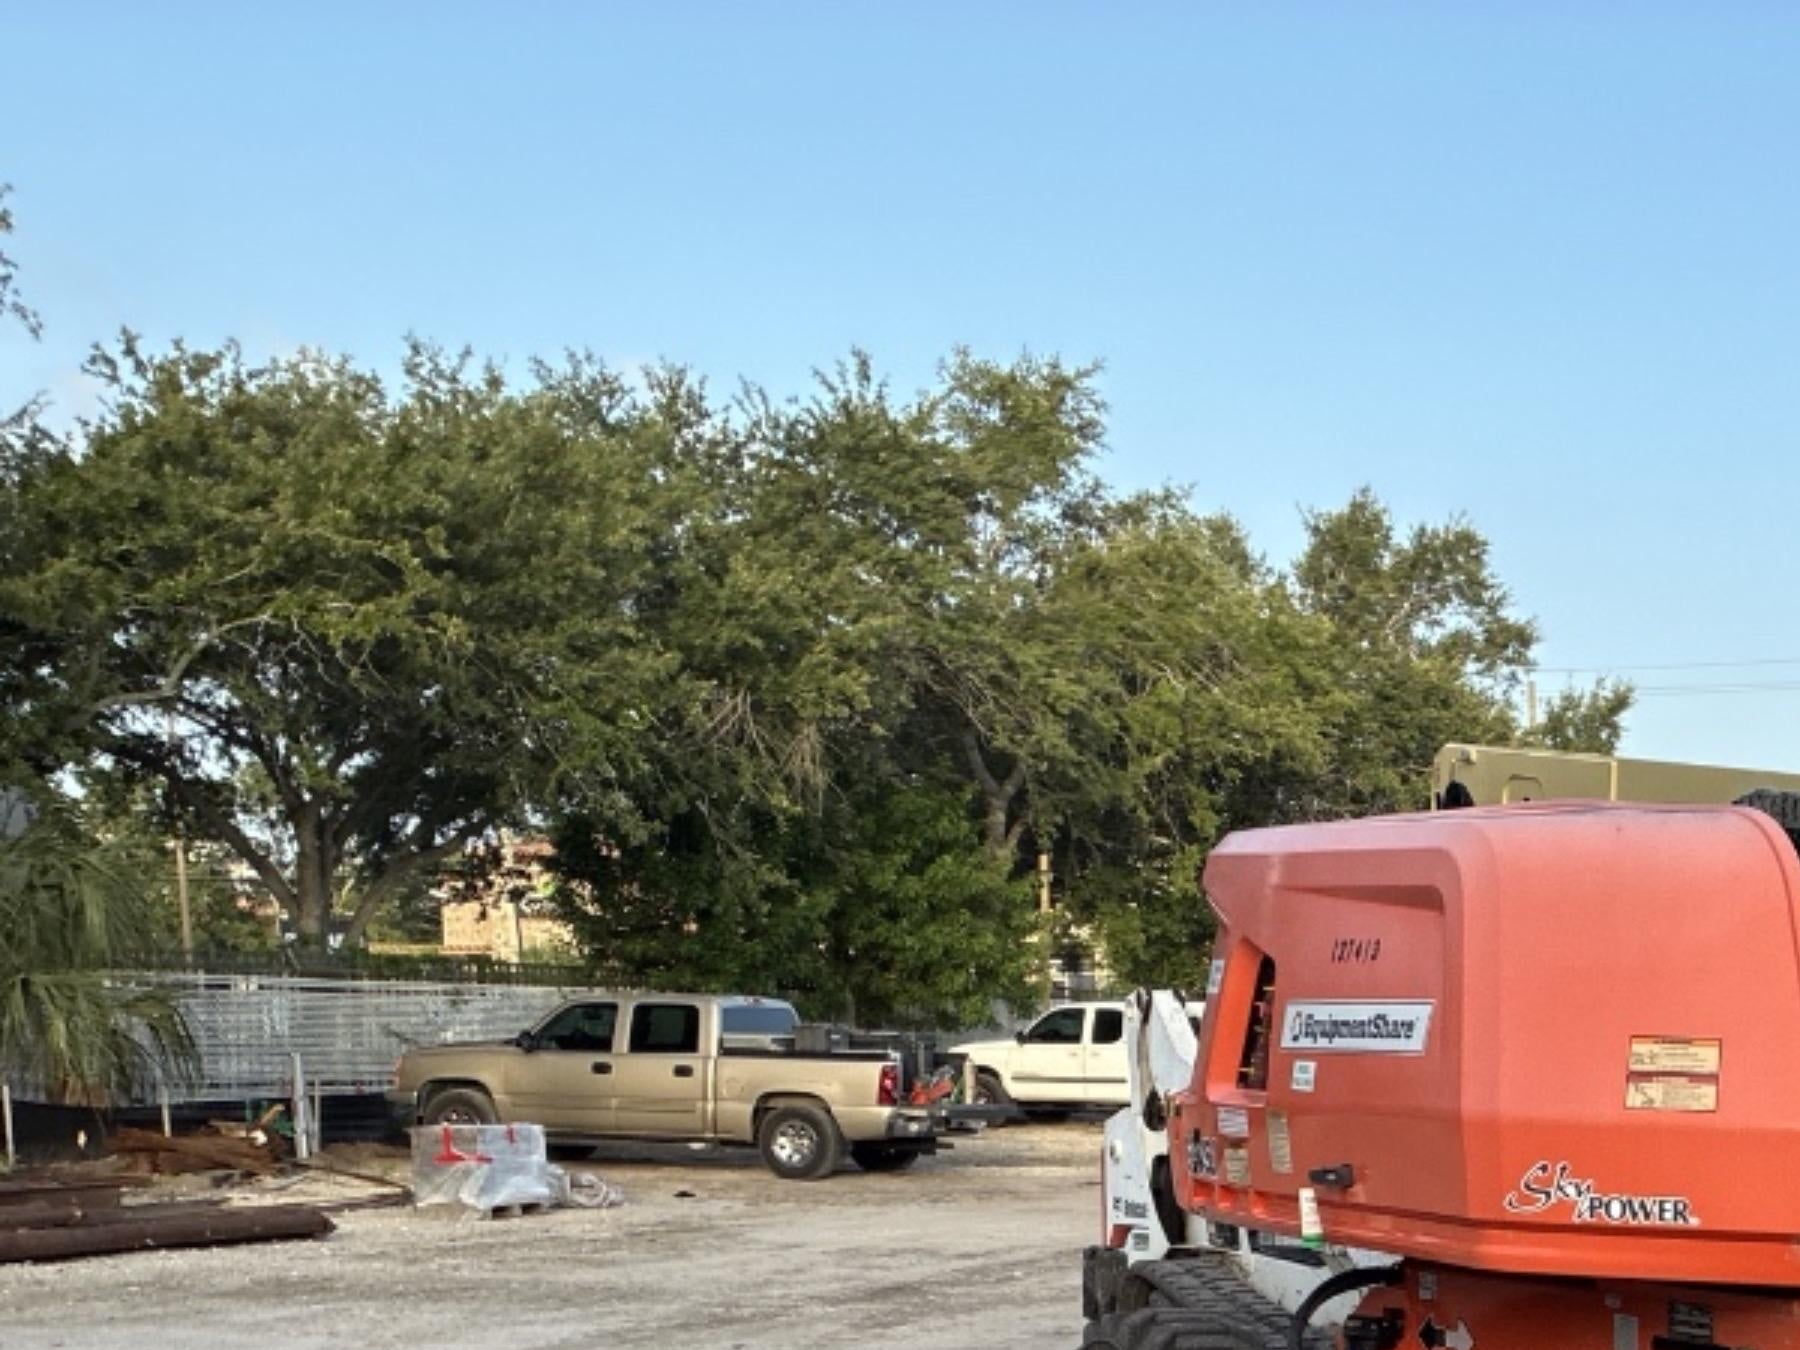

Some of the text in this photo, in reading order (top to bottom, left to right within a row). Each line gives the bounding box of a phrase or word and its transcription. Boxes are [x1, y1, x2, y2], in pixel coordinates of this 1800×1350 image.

[1304, 1013, 1416, 1045] EquipmentShare
[1505, 1162, 1690, 1225] Sky POWER
